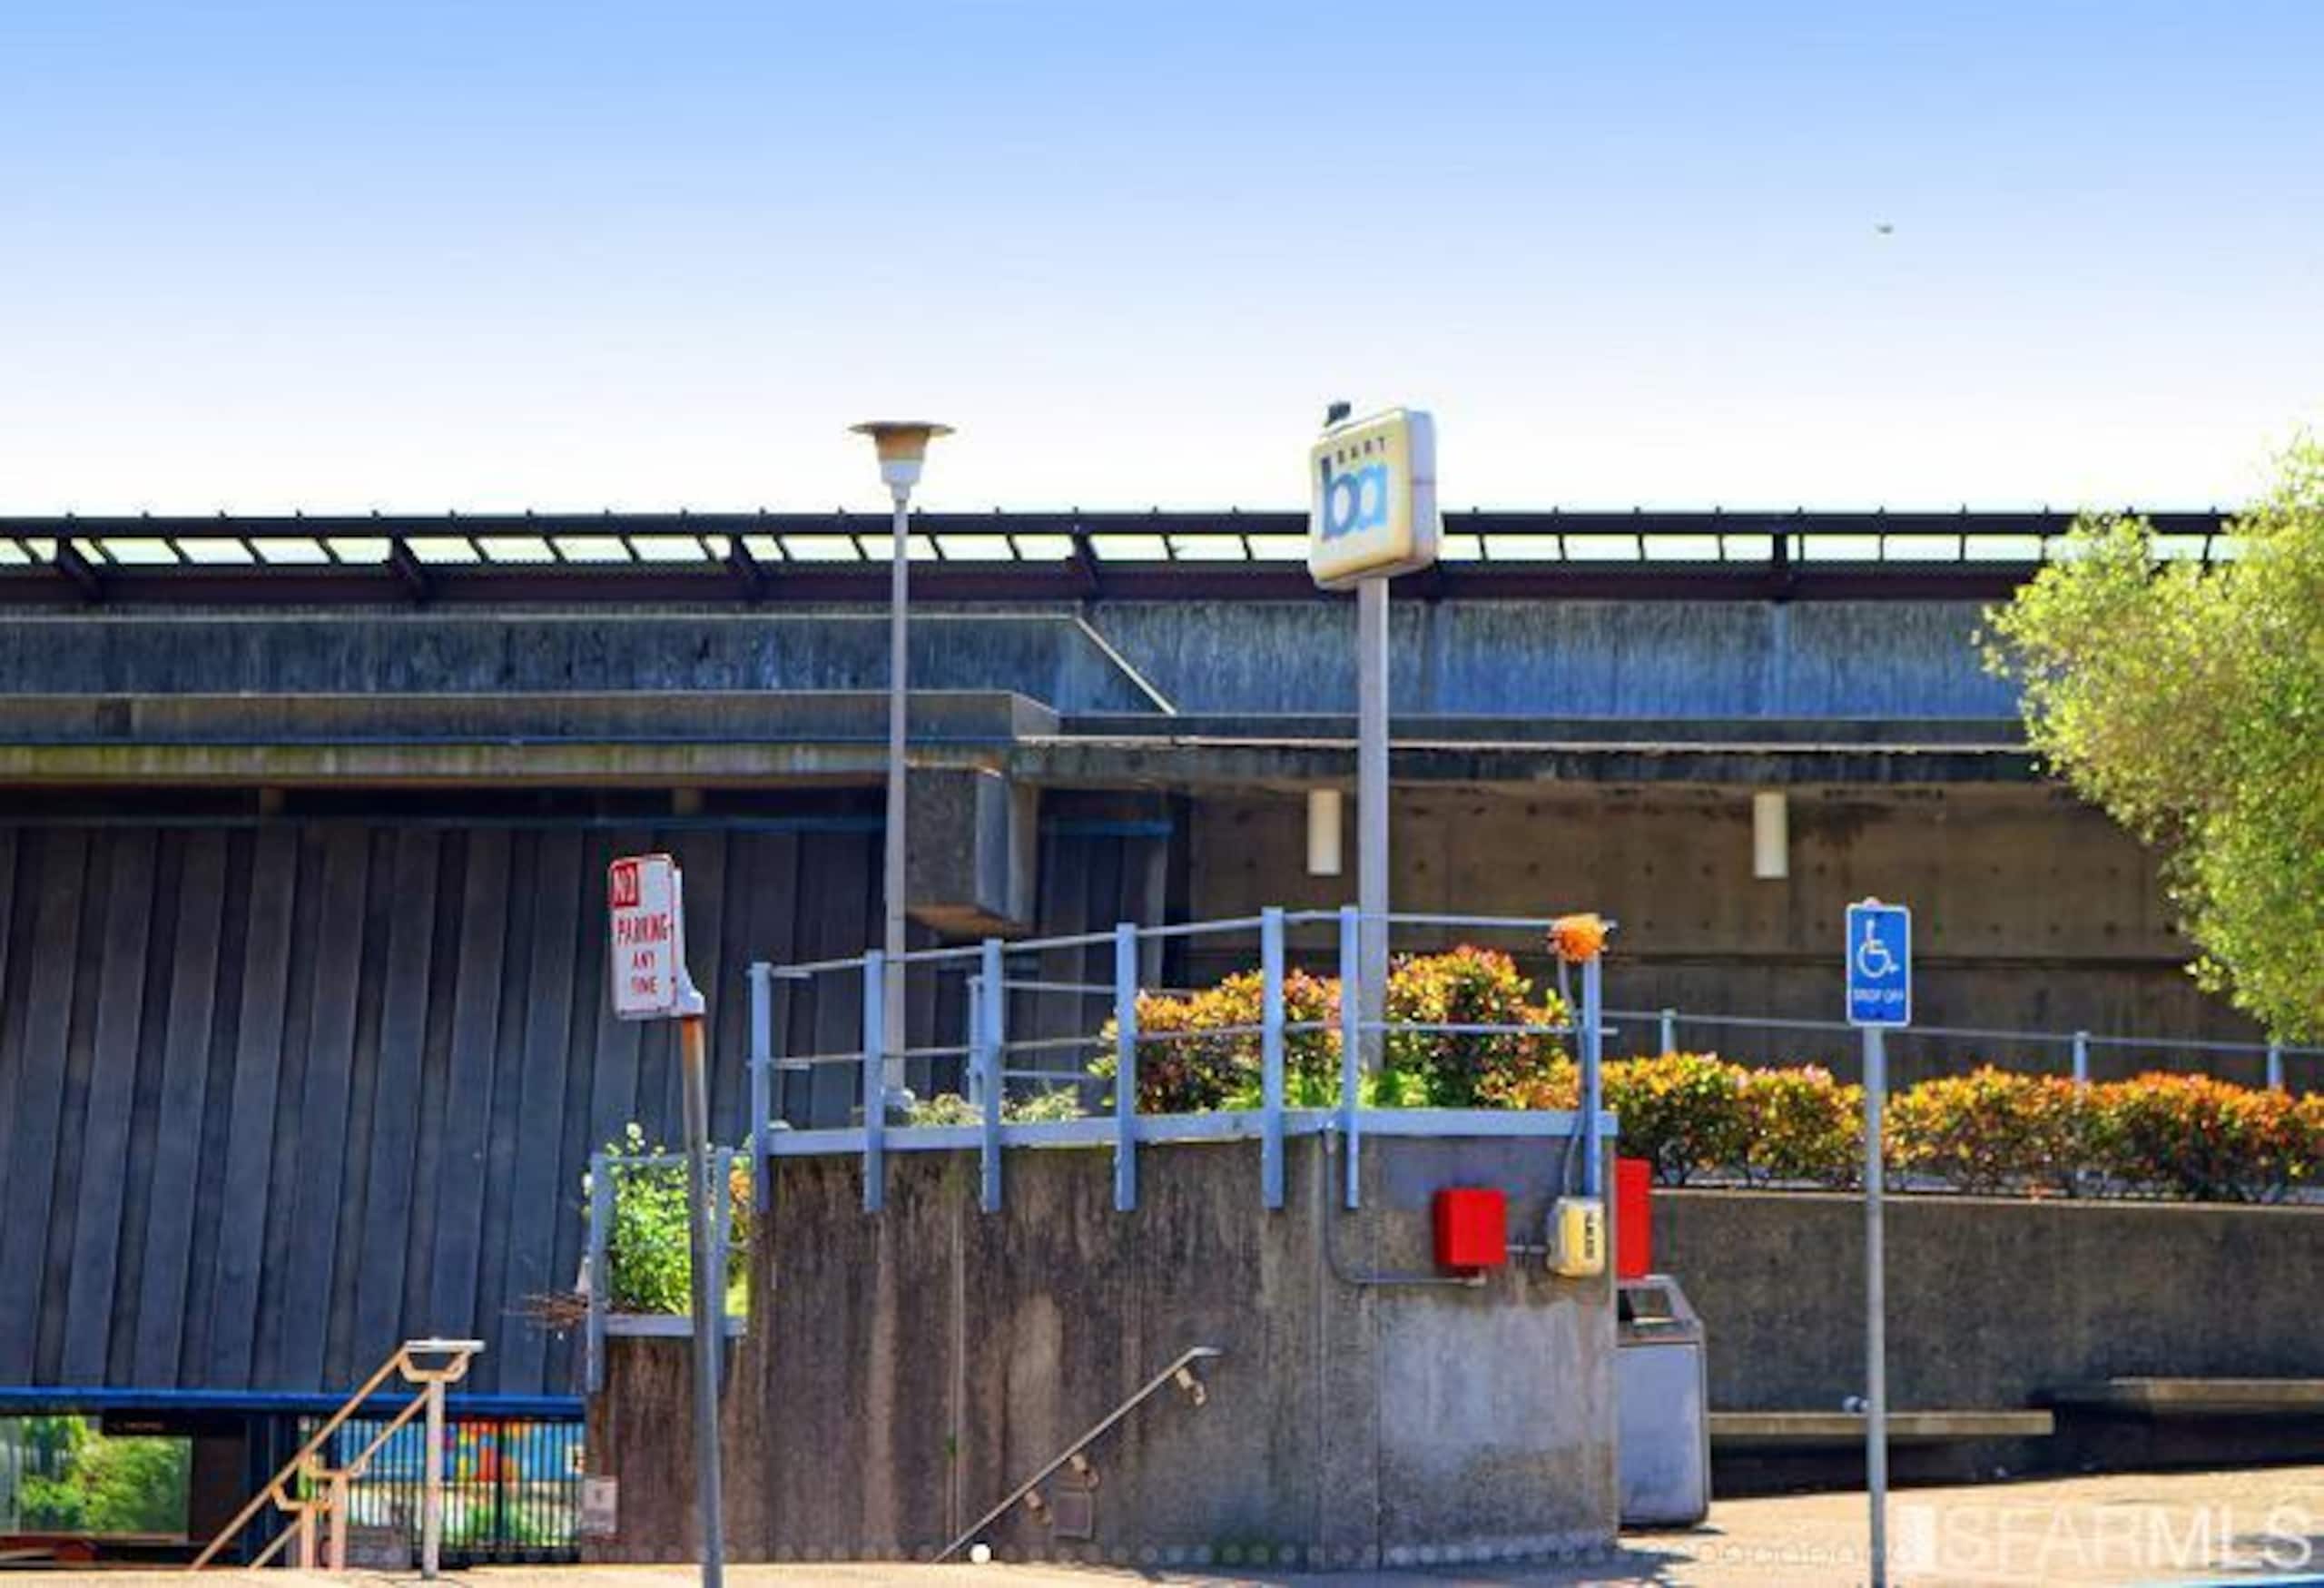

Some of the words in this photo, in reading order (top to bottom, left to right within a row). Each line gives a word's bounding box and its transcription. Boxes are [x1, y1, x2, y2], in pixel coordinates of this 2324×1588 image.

[1321, 456, 1388, 541] ba
[613, 865, 636, 904] NO
[617, 913, 669, 945] PARKING
[632, 951, 655, 969] ANY
[632, 975, 658, 994] TIME
